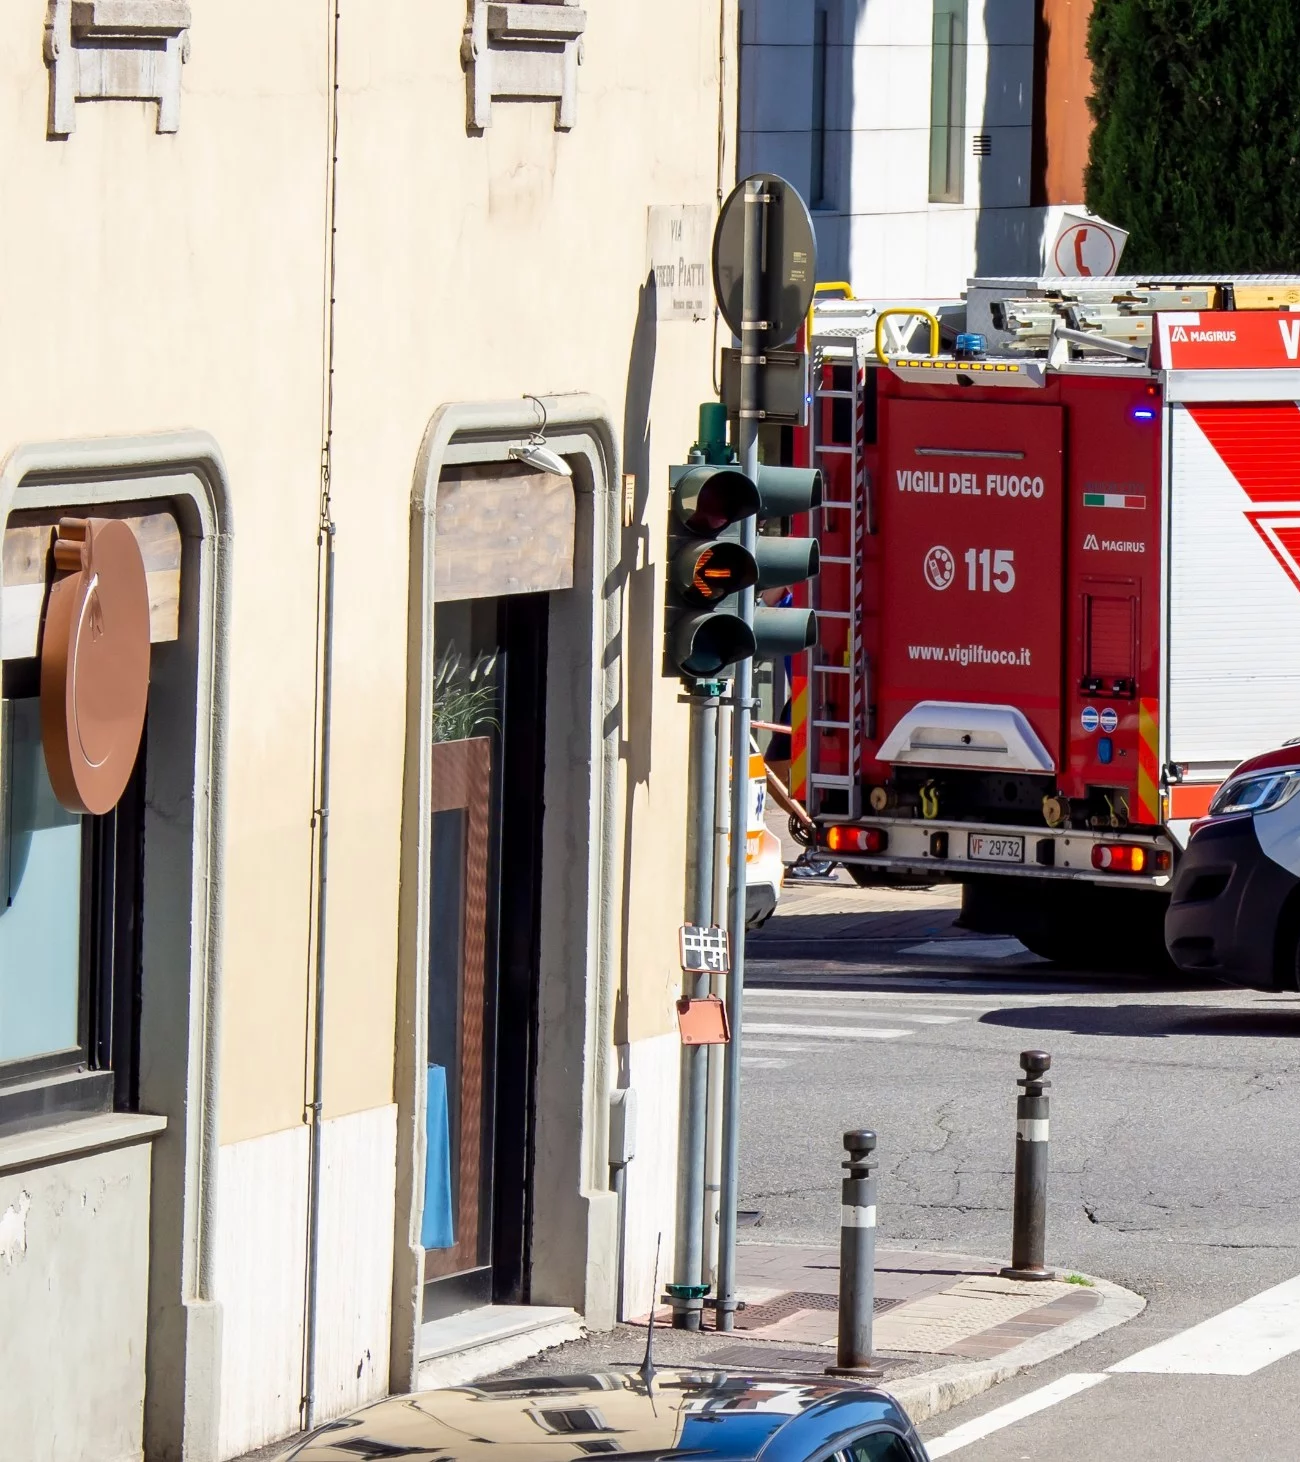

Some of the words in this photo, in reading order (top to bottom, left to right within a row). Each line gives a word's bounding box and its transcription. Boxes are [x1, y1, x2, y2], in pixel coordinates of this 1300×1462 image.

[670, 219, 682, 241] VIA
[679, 257, 705, 287] PIATTI
[1190, 330, 1237, 343] MAGIRUS
[896, 470, 944, 493] VIGILI
[949, 472, 981, 495] DEL
[986, 474, 1044, 498] FUOCO
[1101, 540, 1145, 553] MAGIRUS
[964, 548, 1016, 593] 115
[908, 644, 1031, 666] www.vigilfuoco.it
[972, 839, 984, 855] VF
[988, 840, 1020, 858] 29732
